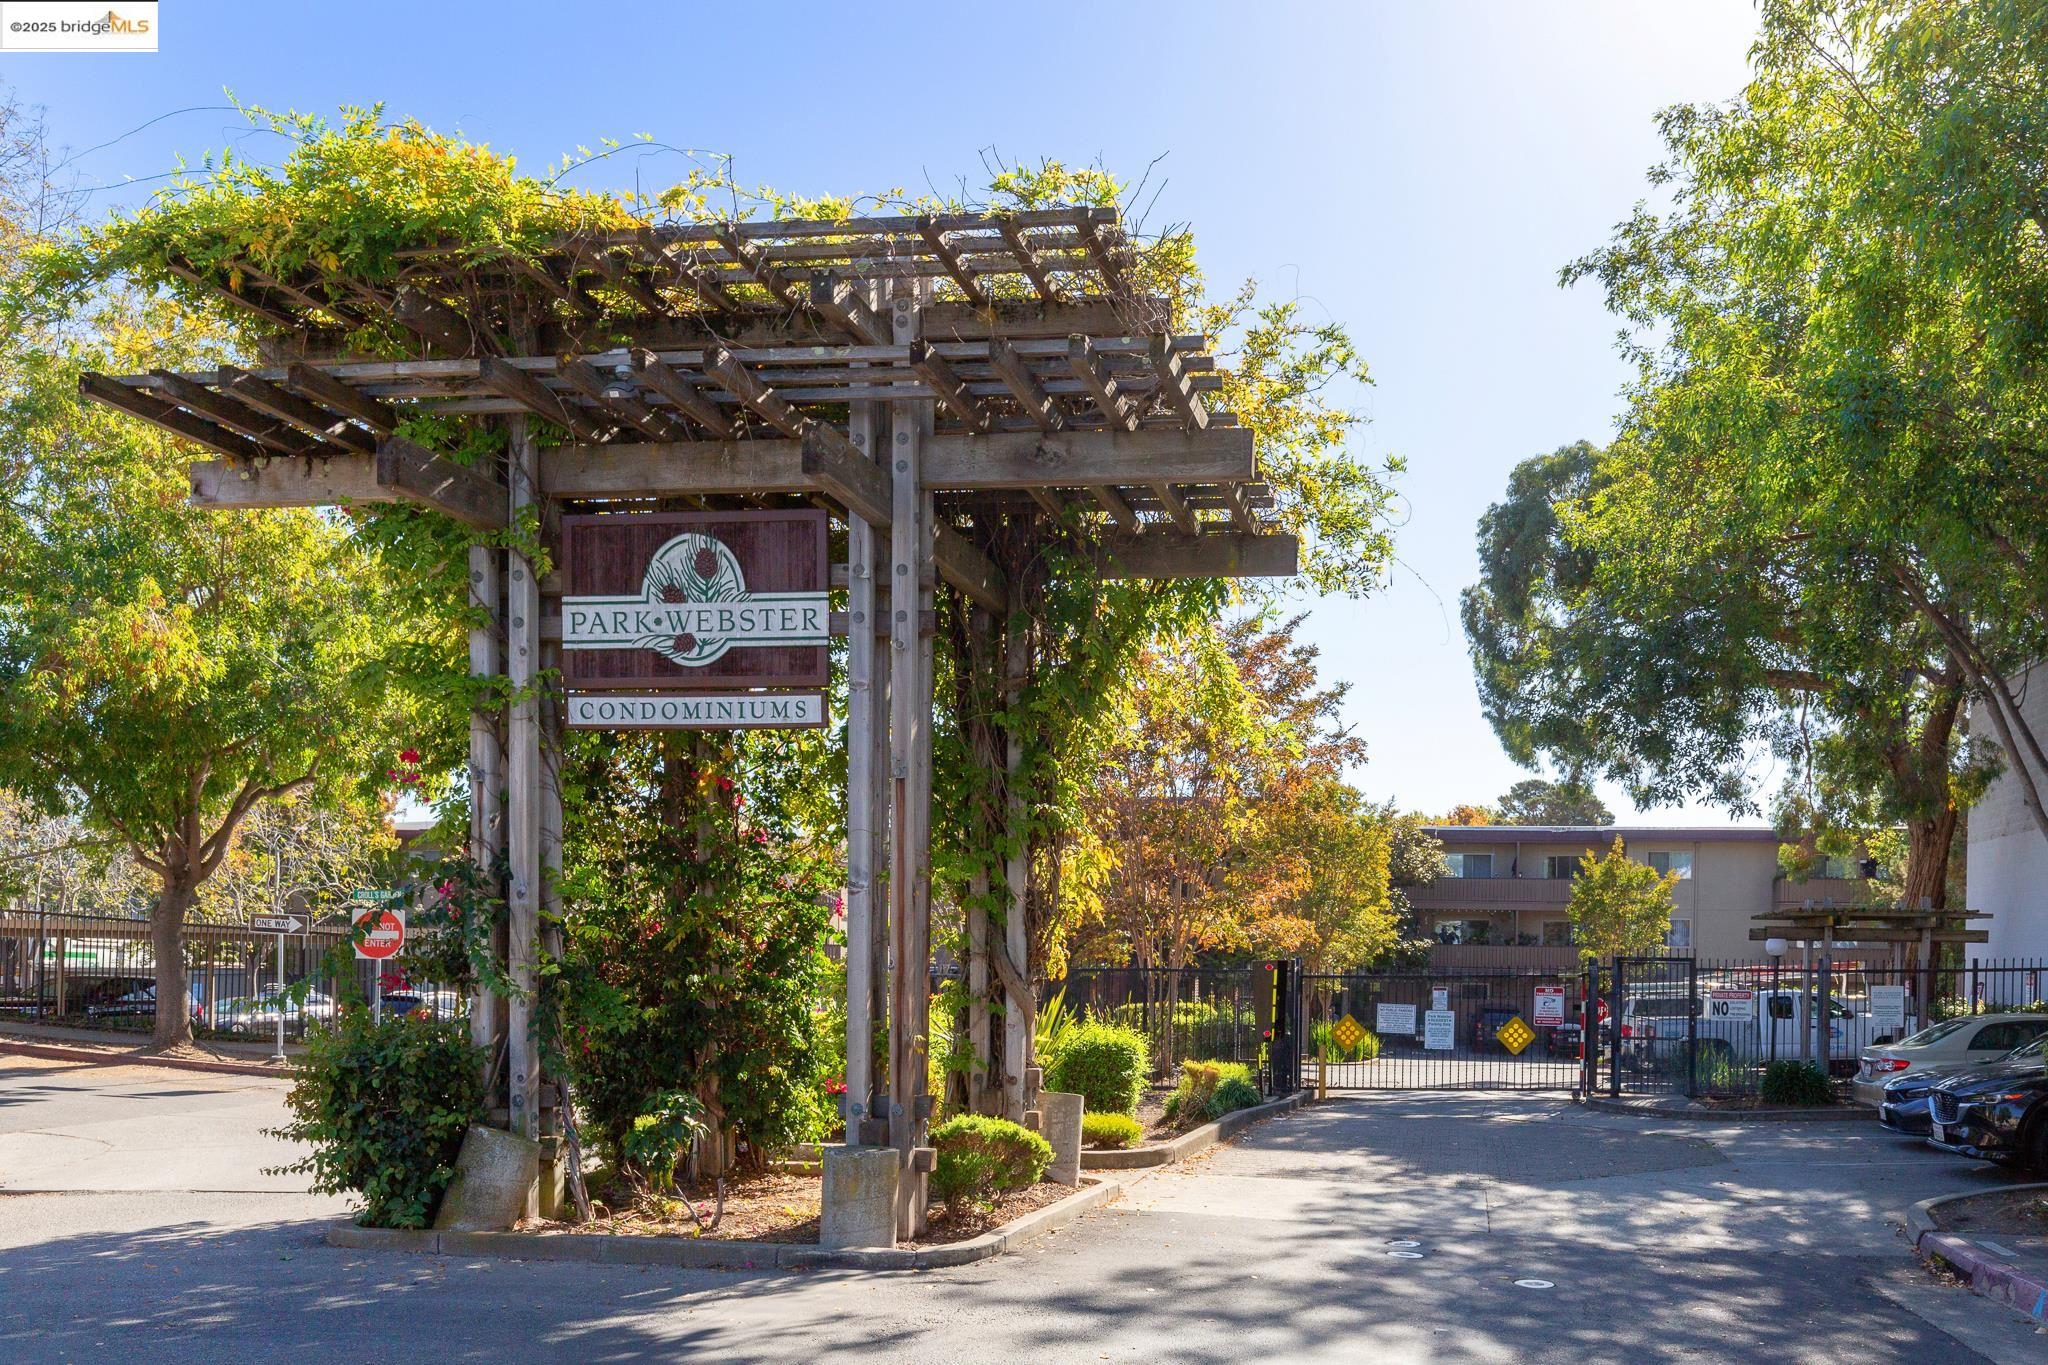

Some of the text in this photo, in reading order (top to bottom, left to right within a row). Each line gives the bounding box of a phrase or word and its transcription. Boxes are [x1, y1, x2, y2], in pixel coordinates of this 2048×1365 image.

[569, 607, 822, 635] PARK WEBSTER
[578, 699, 808, 720] CONDOMINIUMS
[255, 918, 291, 928] ONE WAY
[379, 922, 395, 931] NOT
[364, 938, 392, 948] ENTER
[1712, 1001, 1729, 1016] NO
